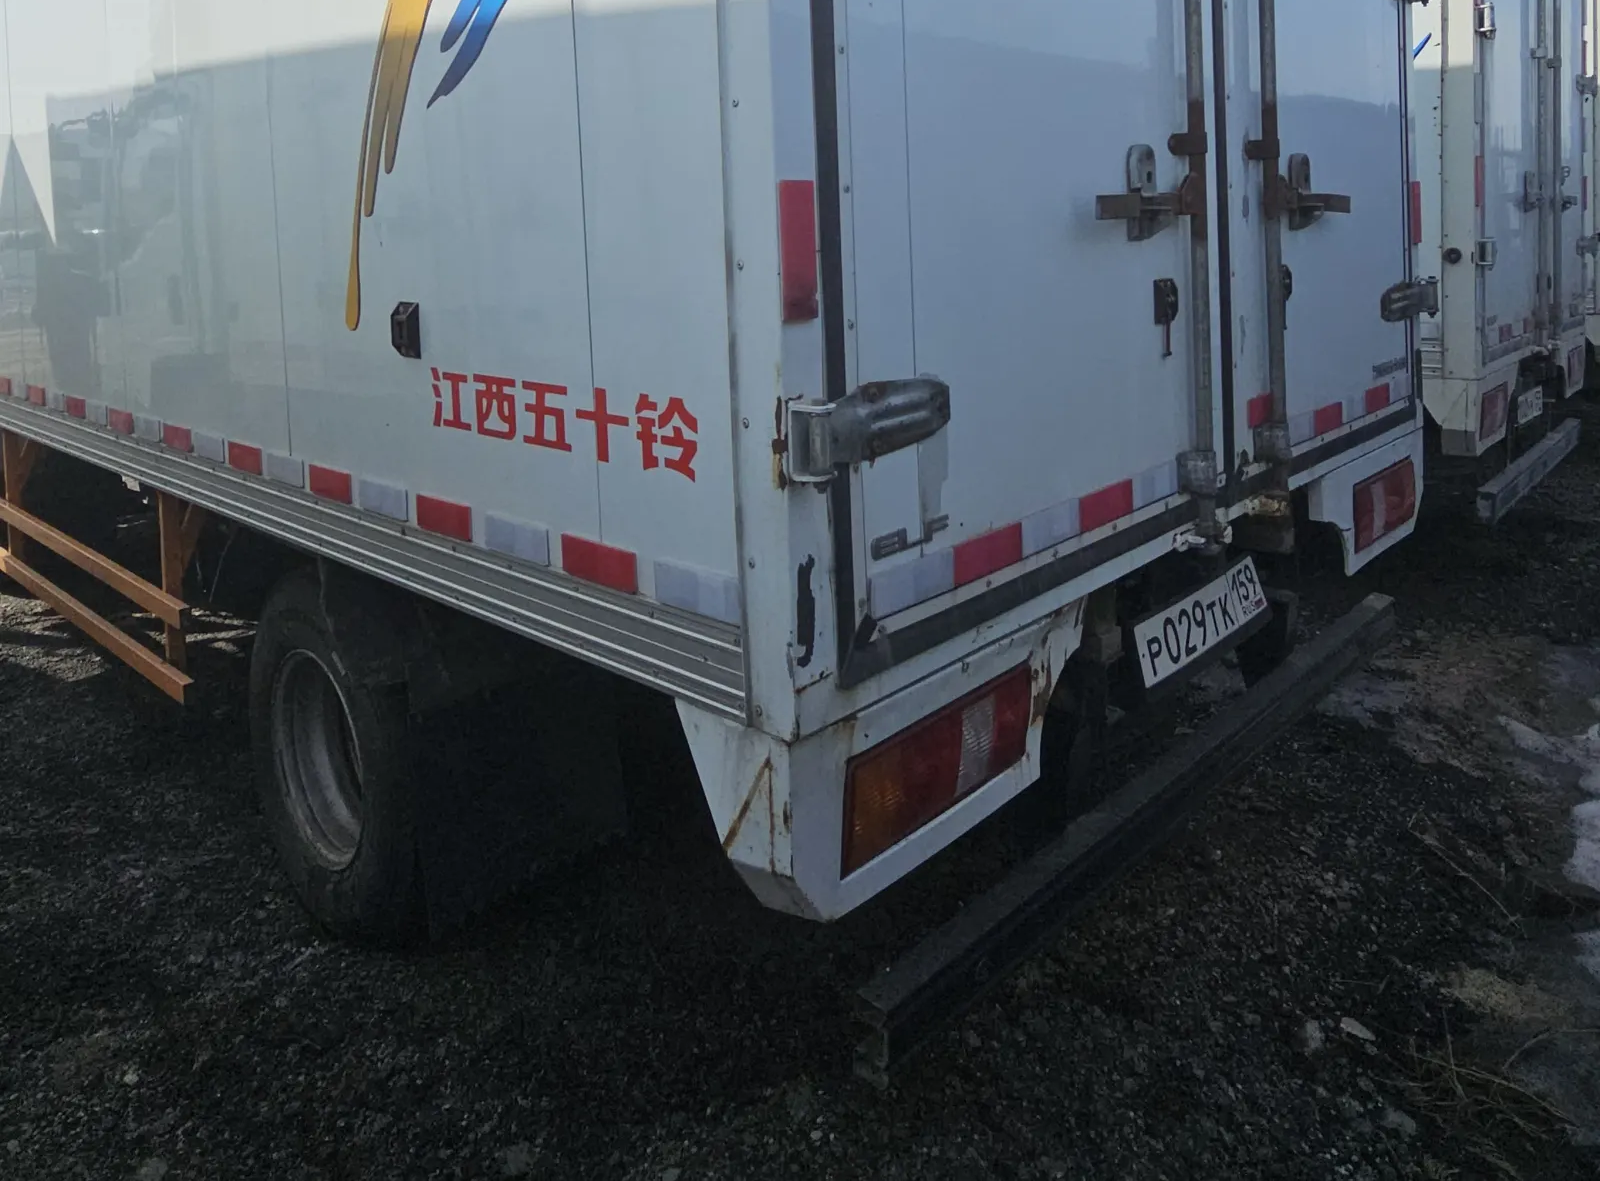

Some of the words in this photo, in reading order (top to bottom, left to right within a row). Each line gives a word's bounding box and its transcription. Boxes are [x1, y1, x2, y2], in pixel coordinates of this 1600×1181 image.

[430, 367, 698, 483] 江西五十铃
[1231, 564, 1256, 606] 159
